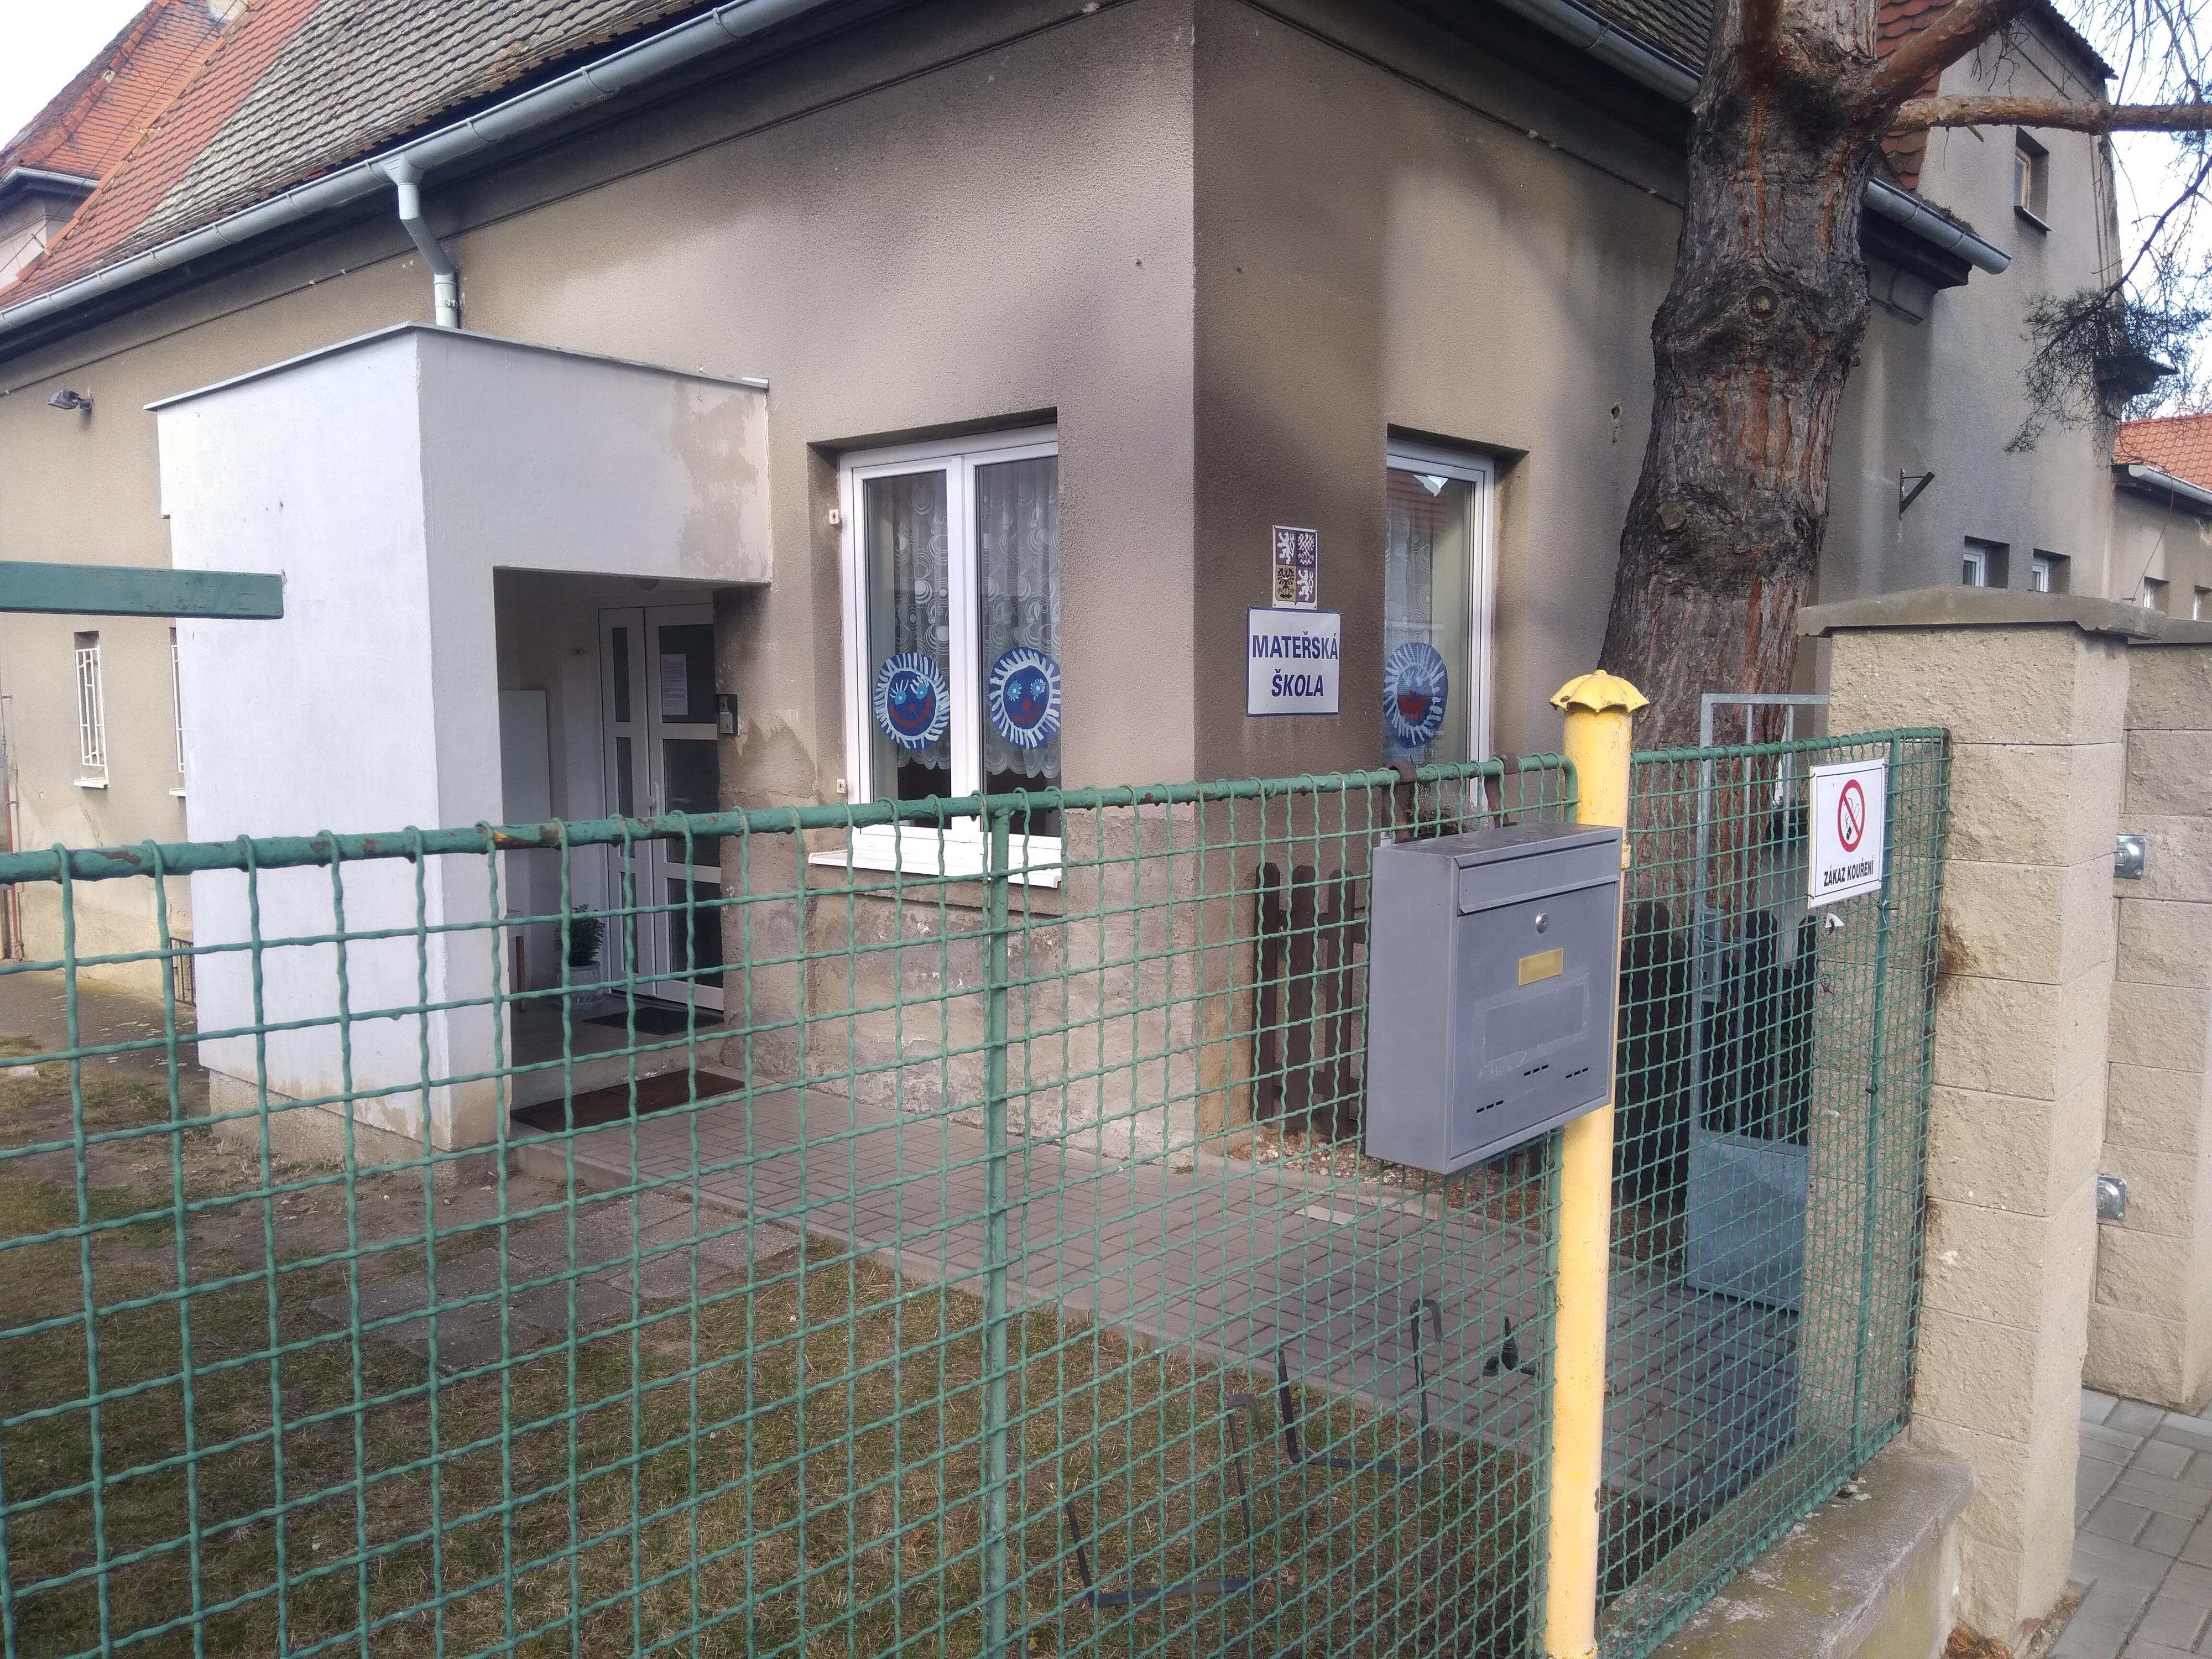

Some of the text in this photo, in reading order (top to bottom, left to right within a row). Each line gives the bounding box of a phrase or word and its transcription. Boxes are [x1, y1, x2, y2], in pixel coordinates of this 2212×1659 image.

[1253, 631, 1338, 659] MATEŘSKÁ
[1271, 669, 1323, 697] ŠKOLA
[1824, 855, 1874, 887] ZÁKAZ KOUŘENÍ
